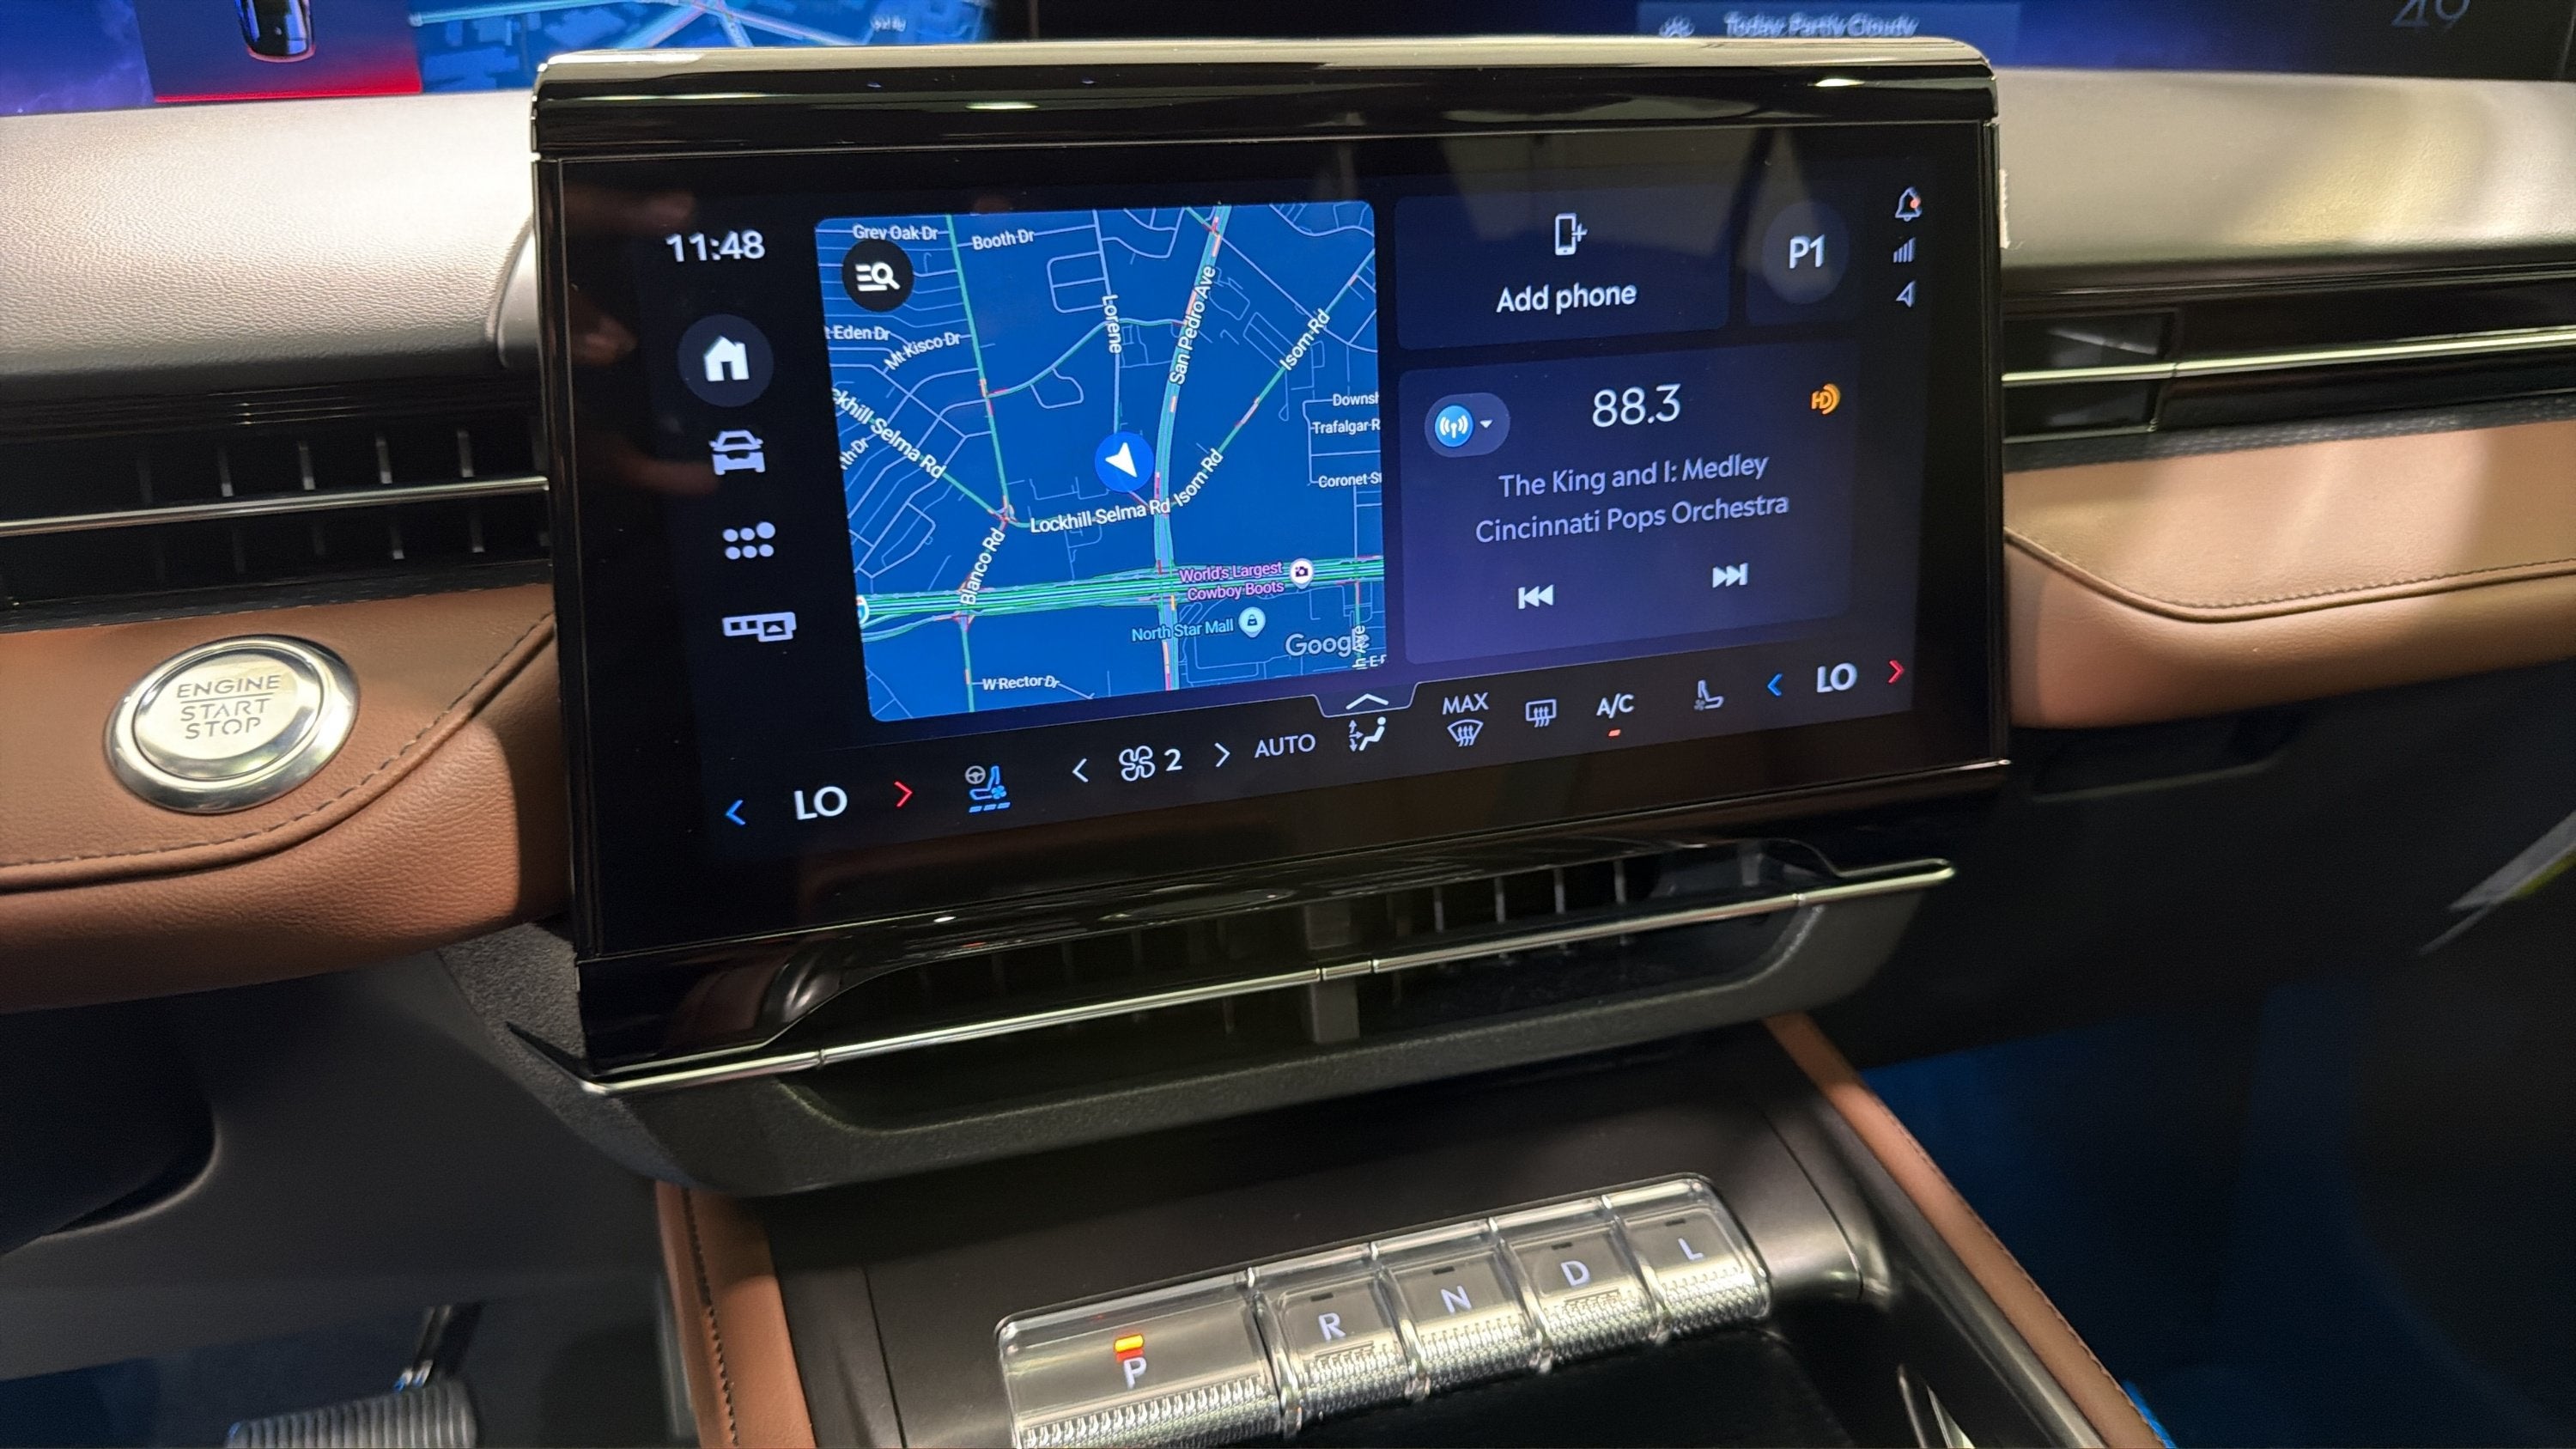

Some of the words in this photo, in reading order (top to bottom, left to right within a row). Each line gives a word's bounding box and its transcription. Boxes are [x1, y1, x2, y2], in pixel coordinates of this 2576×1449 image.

[665, 229, 765, 262] 11:48
[853, 225, 886, 240] Grey
[890, 226, 918, 240] Oak
[921, 227, 939, 240] Dr
[971, 232, 1016, 250] Booth
[1018, 229, 1035, 244] Dr
[1789, 234, 1826, 269] P1
[1194, 265, 1216, 301] Ave
[1496, 283, 1550, 314] Add
[1556, 282, 1637, 315] phone
[833, 326, 872, 340] Eden
[874, 326, 890, 340] Dr
[1102, 294, 1122, 354] Lorene
[1178, 300, 1206, 351] Pedro
[884, 350, 905, 369] Mt
[904, 335, 944, 357] Kisco
[945, 332, 962, 347] Dr
[1279, 332, 1314, 370] Isom
[1307, 307, 1331, 336] Rd
[1169, 351, 1191, 385] San
[1592, 383, 1682, 429] 88.3
[1312, 419, 1368, 435] Trafalgar
[850, 437, 869, 454] Dr
[871, 417, 920, 462] Selma
[920, 454, 947, 479] Rd
[1173, 471, 1209, 507] Isom
[1200, 447, 1224, 473] Rd
[1318, 472, 1367, 488] Coronet
[1498, 474, 1546, 497] The
[1552, 468, 1606, 495] King
[1612, 461, 1657, 487] and
[1682, 454, 1770, 481] Medley
[1095, 503, 1147, 525] Selma
[1149, 497, 1171, 516] Rd
[1475, 509, 1600, 543] Cincinnati
[1607, 506, 1667, 533] Pops
[1671, 494, 1789, 525] Orchestra
[959, 551, 993, 606] Blanco
[981, 527, 1006, 552] Rd
[1179, 567, 1229, 583] World's
[1232, 561, 1283, 579] Largest
[1187, 585, 1242, 601] Cowboy
[1245, 581, 1285, 596] Boots
[1132, 624, 1171, 642] North
[1173, 623, 1203, 638] Star
[1205, 618, 1234, 635] Mall
[177, 675, 282, 697] ENGINE
[982, 678, 998, 691] W
[999, 675, 1042, 690] Rector
[1044, 675, 1060, 689] Dr
[1816, 662, 1858, 693] LO
[179, 698, 271, 721] START
[1442, 691, 1490, 715] MAX
[1595, 693, 1635, 718] A/C
[185, 716, 261, 739] STOP
[1163, 747, 1182, 772] 2
[1254, 733, 1316, 758] AUTO
[793, 785, 848, 821] LO
[1679, 1236, 1704, 1261] L
[1561, 1260, 1590, 1288] D
[1438, 1285, 1473, 1313] N
[1317, 1312, 1342, 1341] R
[1123, 1357, 1147, 1390] P
